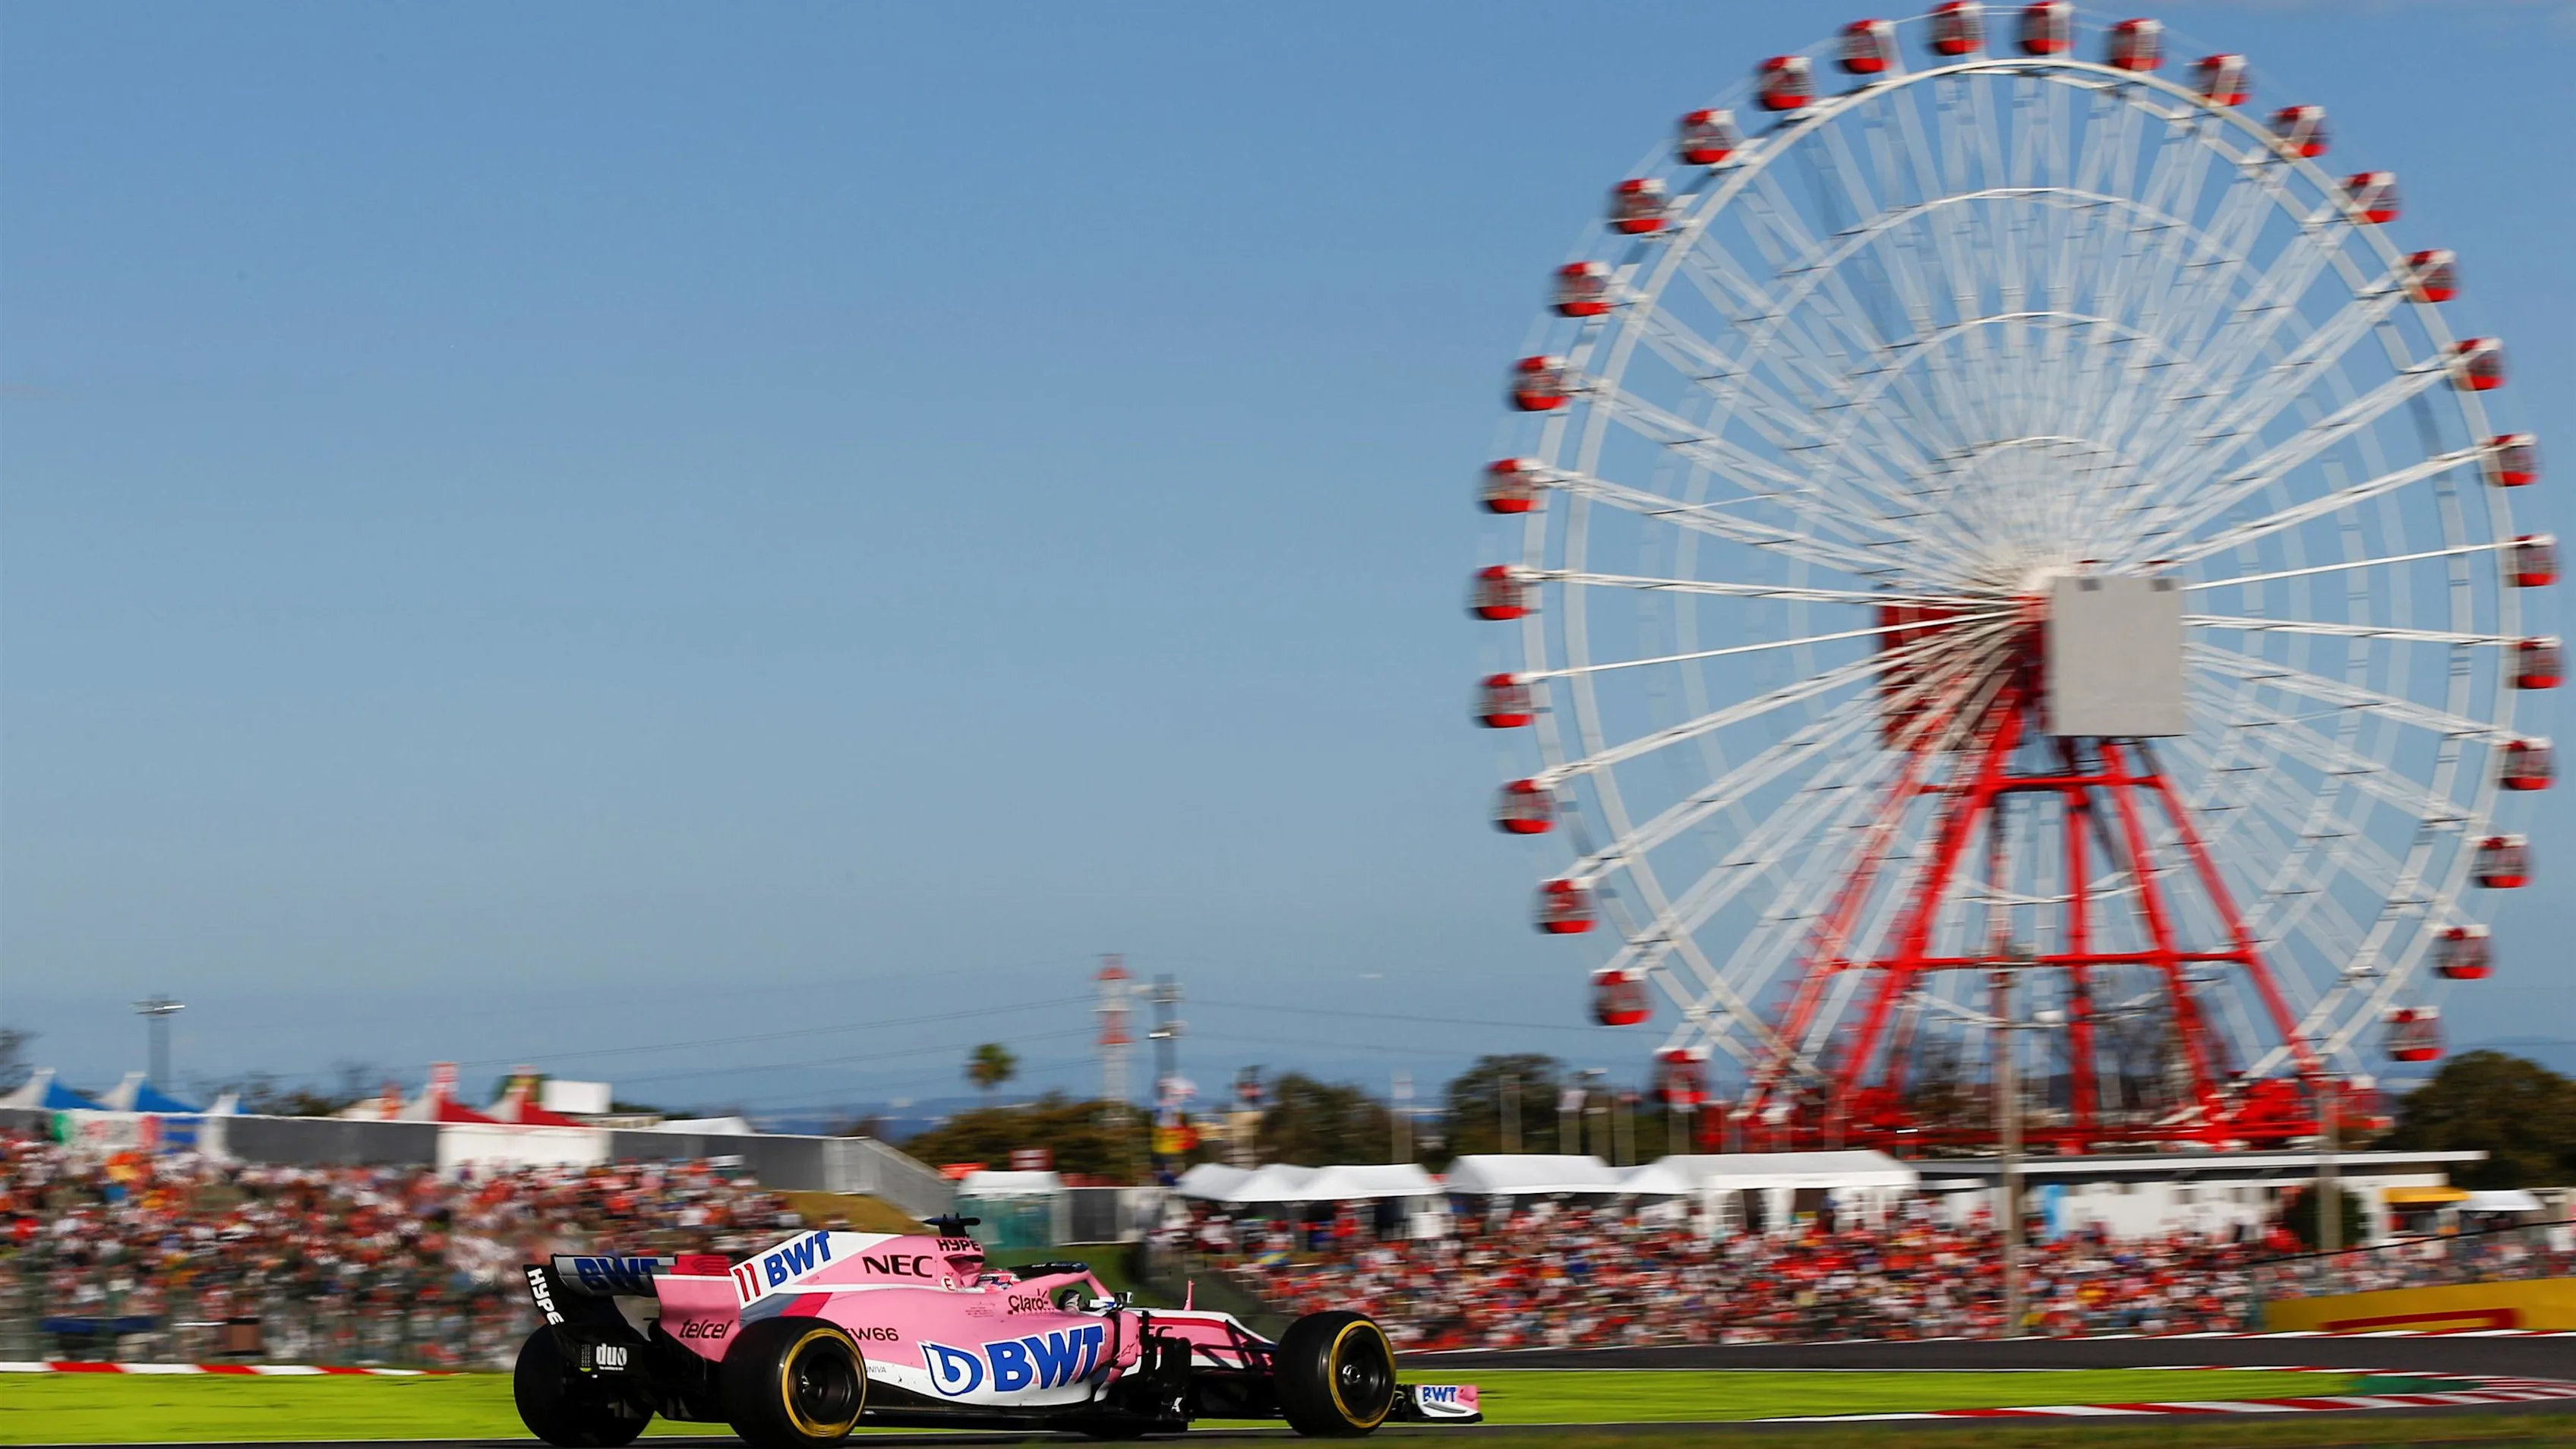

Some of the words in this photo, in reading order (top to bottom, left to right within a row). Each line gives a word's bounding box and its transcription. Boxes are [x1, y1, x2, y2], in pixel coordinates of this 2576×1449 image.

[936, 1239, 981, 1252] HYPE
[764, 1230, 832, 1288] BWT
[862, 1255, 933, 1278] NEC
[574, 1258, 659, 1292] BWT
[733, 1262, 761, 1302] 11
[944, 1278, 955, 1291] E
[527, 1267, 564, 1325] HYPE
[1009, 1294, 1044, 1312] Claro
[679, 1318, 734, 1339] telcel
[844, 1327, 899, 1341] W66
[595, 1342, 627, 1366] duo
[985, 1324, 1103, 1392] BWT
[1423, 1387, 1456, 1402] BWT
